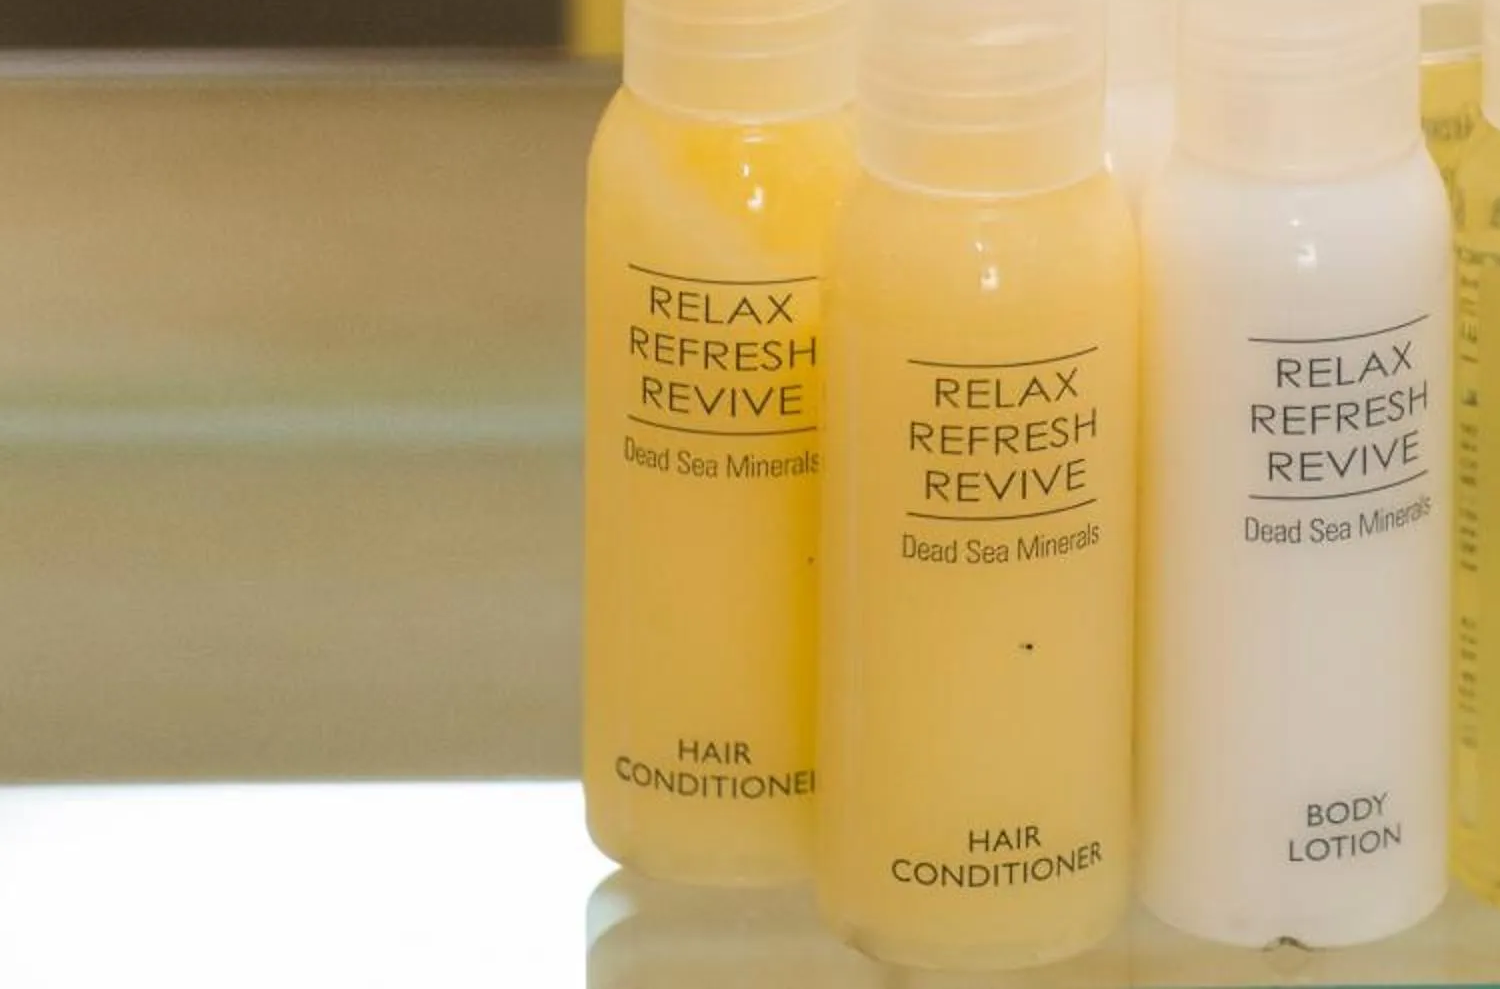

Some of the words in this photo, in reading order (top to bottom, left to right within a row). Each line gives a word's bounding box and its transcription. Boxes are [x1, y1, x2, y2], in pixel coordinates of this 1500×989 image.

[650, 285, 793, 325] RELAX
[630, 324, 817, 372] REFRESH
[1276, 340, 1412, 388] RELAX
[642, 375, 804, 418] REVIVE
[935, 367, 1078, 409] RELAX
[1251, 379, 1427, 435] REFRESH
[909, 407, 1097, 456] REFRESH
[623, 435, 670, 472] Dead
[677, 449, 718, 479] Sea
[727, 449, 820, 479] Minerals
[1268, 430, 1419, 482] REVIVE
[925, 458, 1086, 502] REVIVE
[1244, 515, 1302, 544] Dead
[1309, 517, 1351, 544] Sea
[1358, 495, 1432, 538] Minerals
[902, 532, 957, 563] Dead
[965, 539, 1009, 564] Sea
[1017, 523, 1101, 560] Minerals
[678, 738, 752, 765] HAIR
[1306, 792, 1388, 827] BODY
[969, 825, 1041, 853] HAIR
[1288, 822, 1401, 862] LOTION
[891, 841, 1103, 888] CONDITIONER
